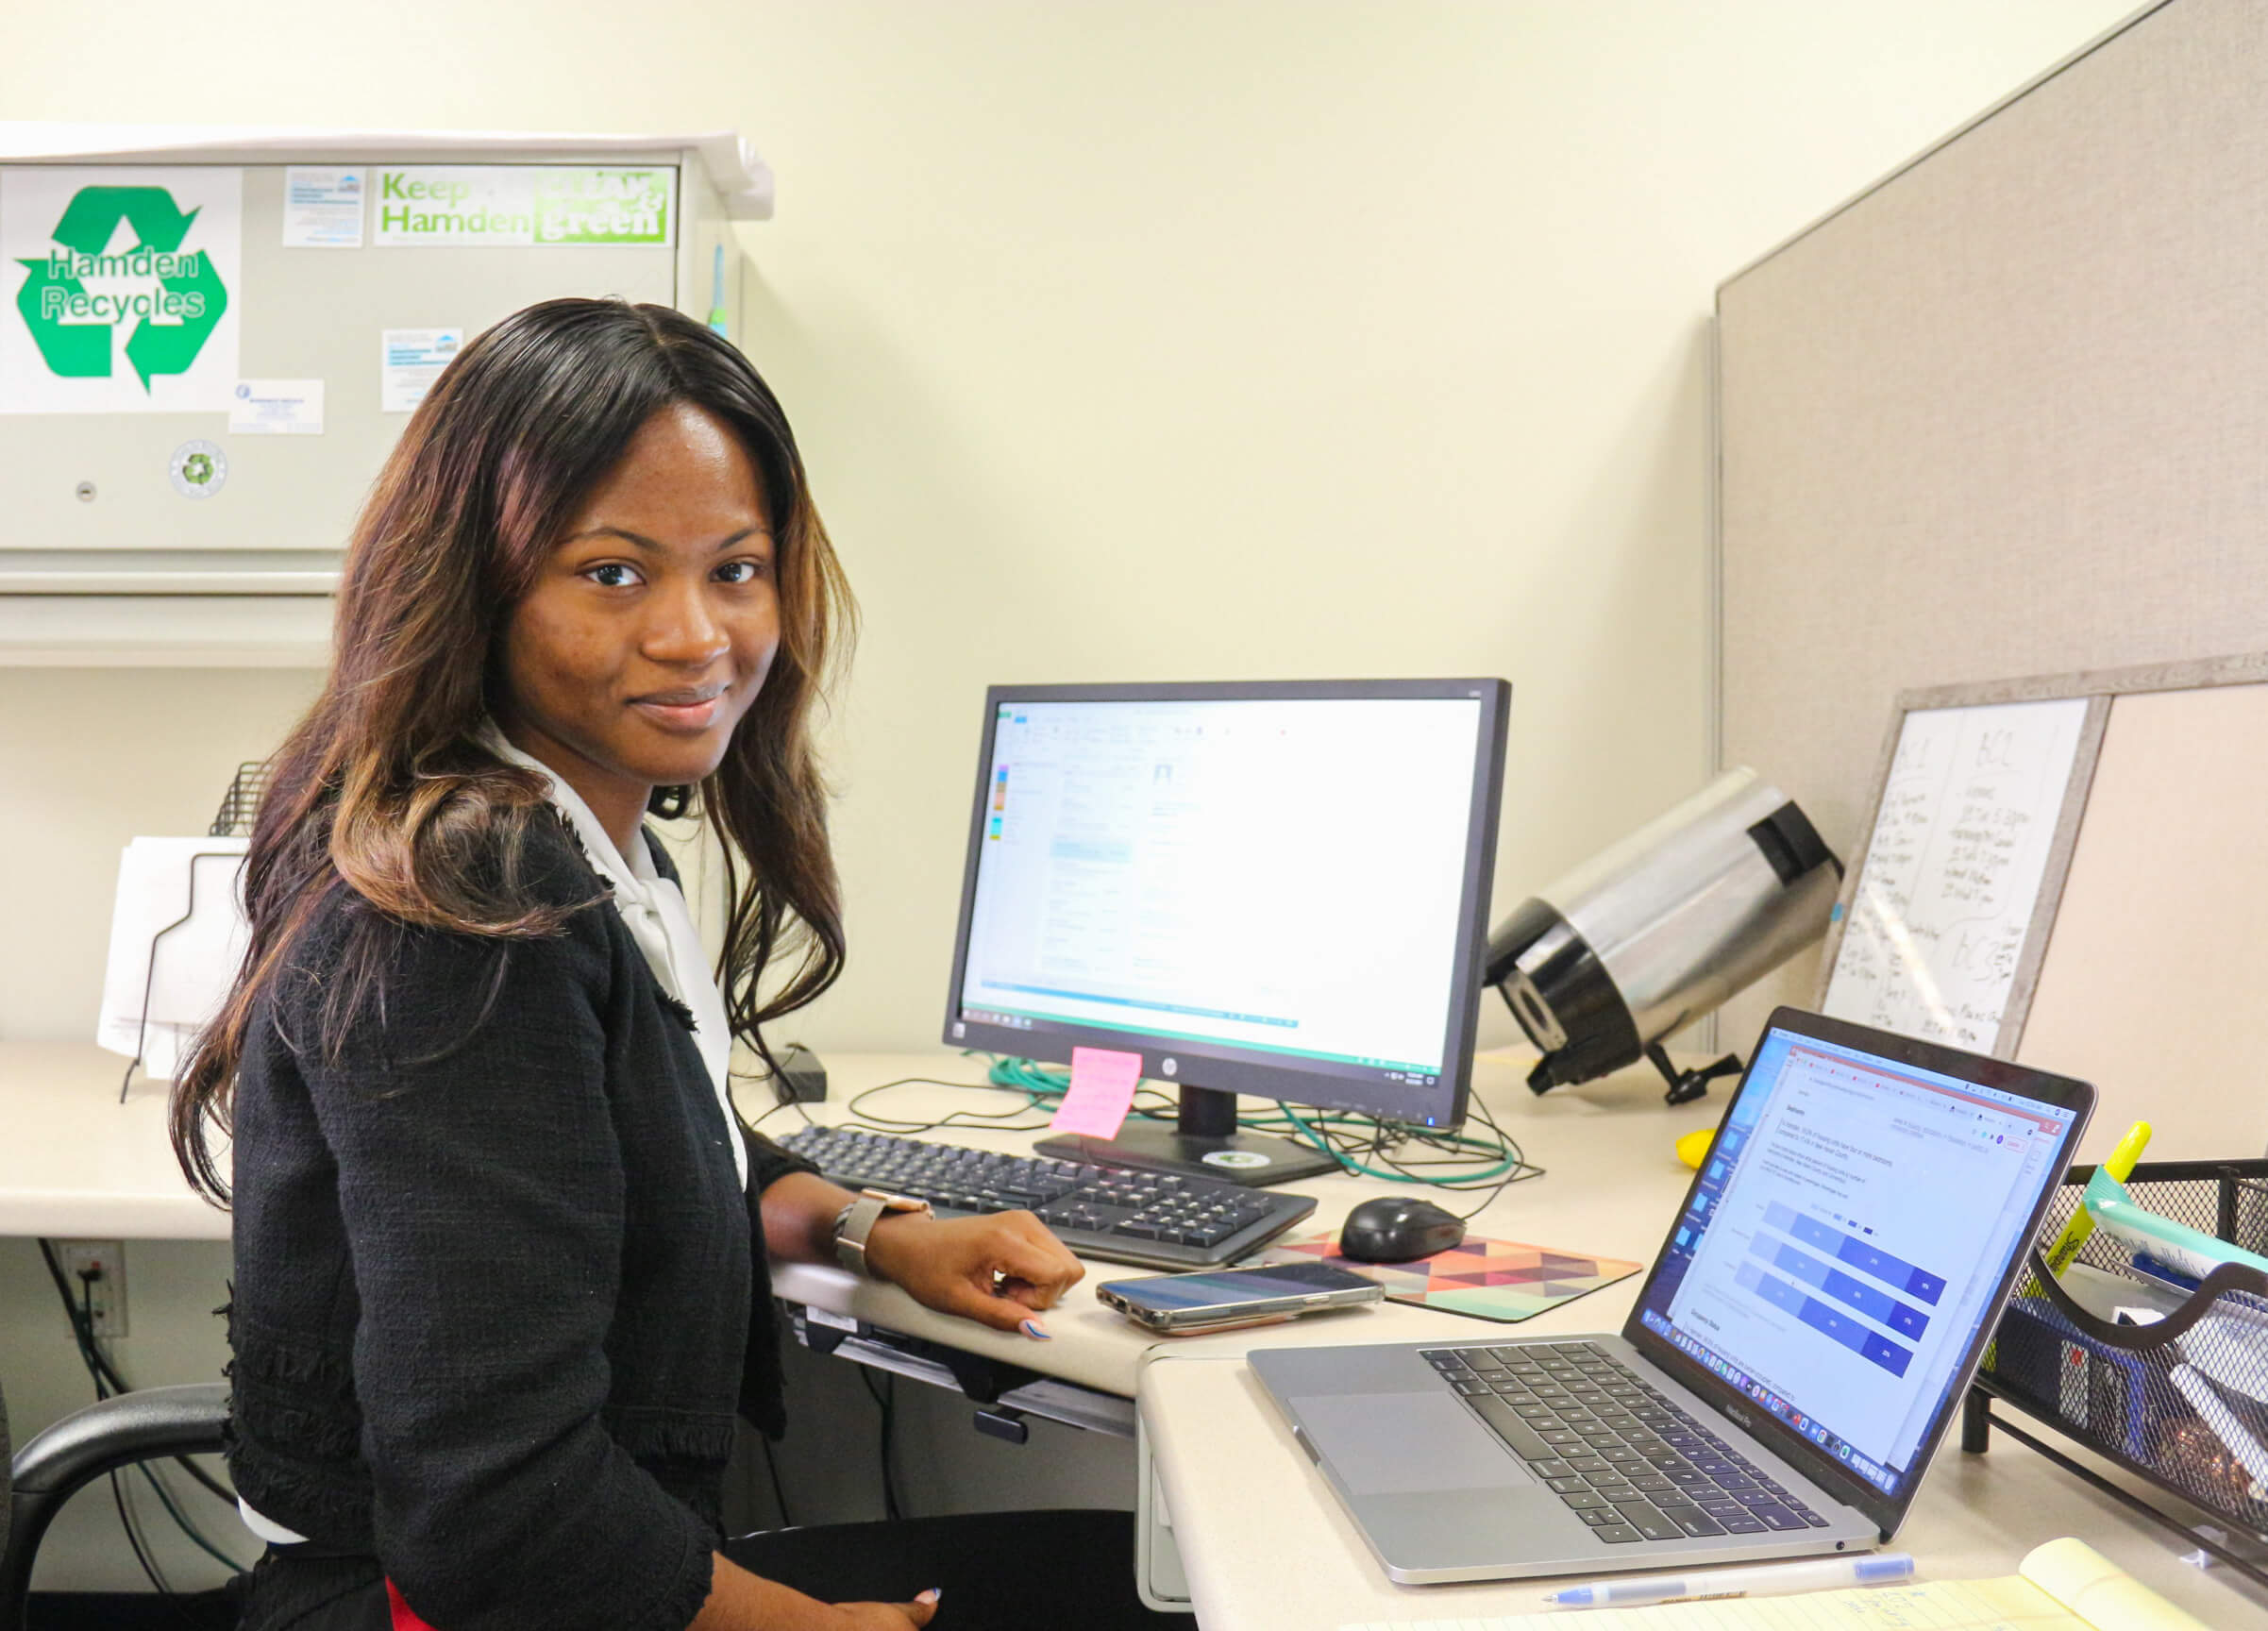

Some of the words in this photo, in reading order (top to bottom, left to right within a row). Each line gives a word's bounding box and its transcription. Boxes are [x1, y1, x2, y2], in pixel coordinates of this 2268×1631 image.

[381, 172, 470, 208] Keep
[381, 204, 529, 233] Hamden
[543, 206, 659, 241] green
[48, 245, 199, 279] Hamden
[42, 285, 207, 325] Recycles
